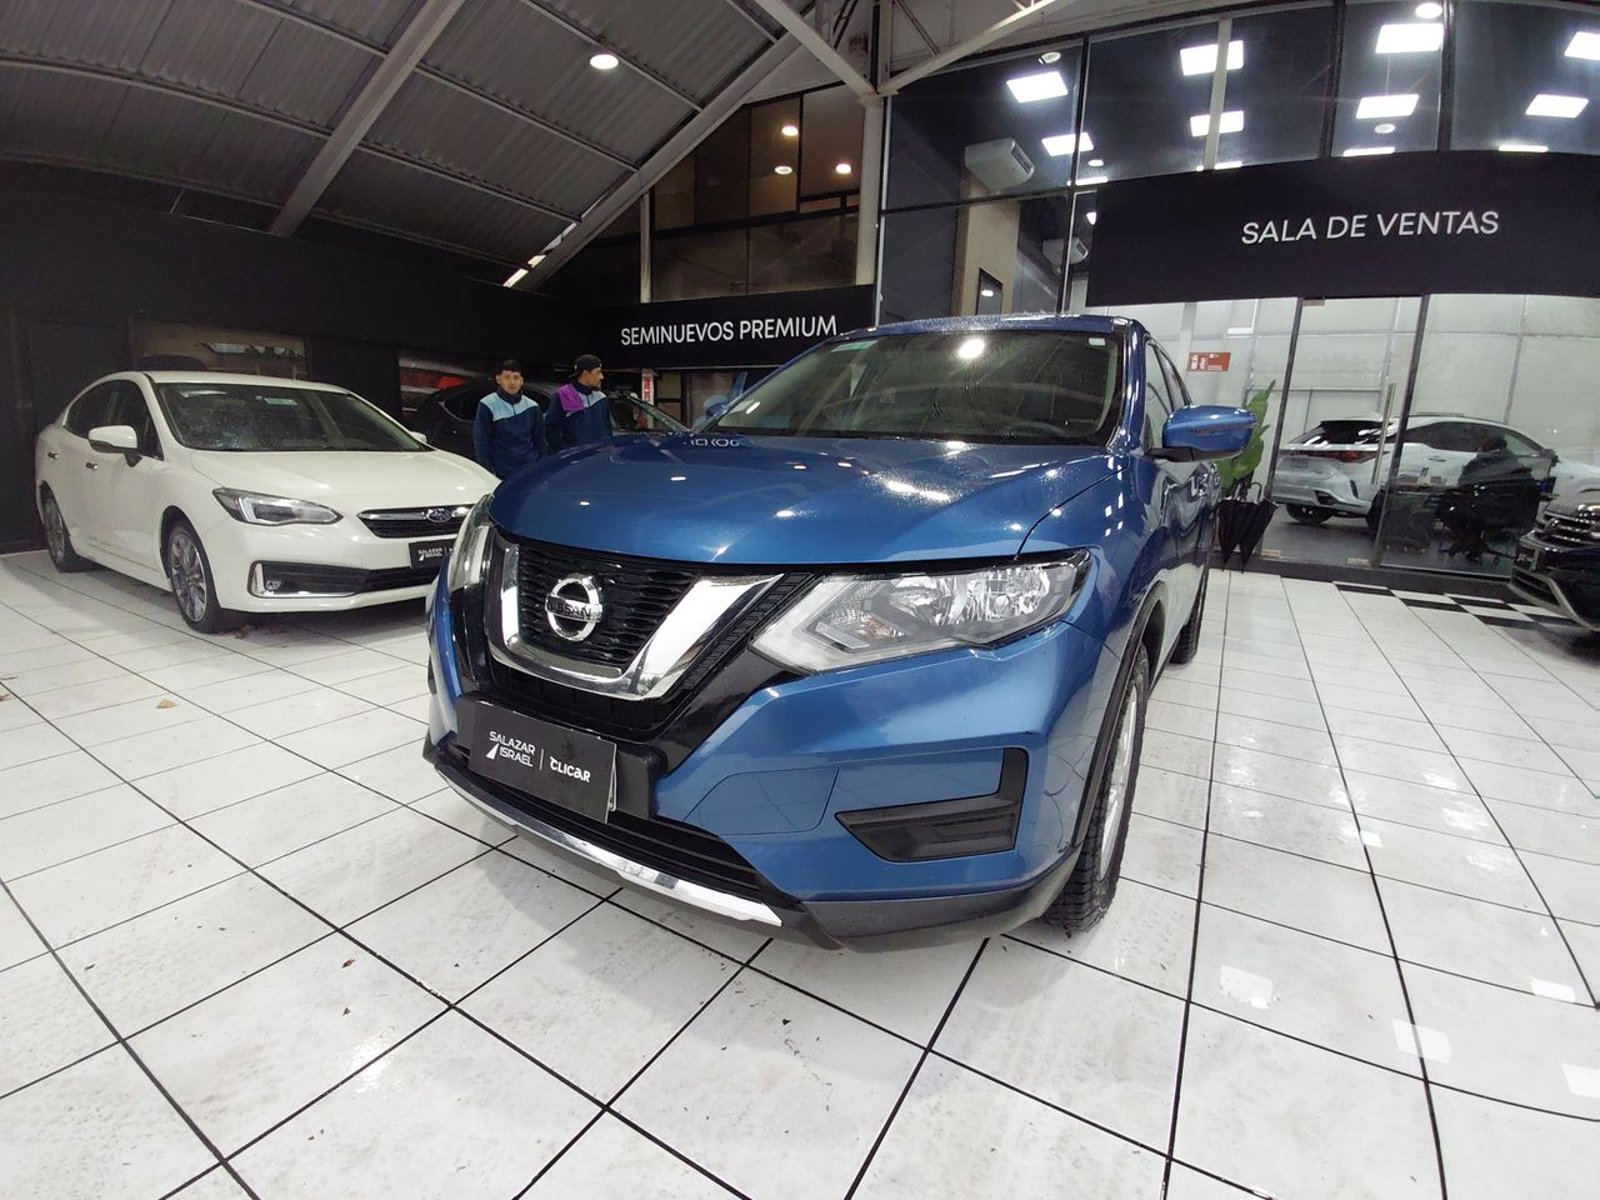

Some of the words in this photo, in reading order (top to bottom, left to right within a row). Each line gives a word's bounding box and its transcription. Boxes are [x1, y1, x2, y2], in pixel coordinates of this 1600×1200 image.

[1241, 217, 1317, 245] SALA
[1325, 214, 1368, 239] DE
[1376, 211, 1500, 236] VENTAS
[620, 321, 735, 346] SEMINUEVOS
[739, 315, 838, 341] PREMIUM
[489, 730, 536, 756] SALAZAR
[499, 746, 534, 767] ISRAEL
